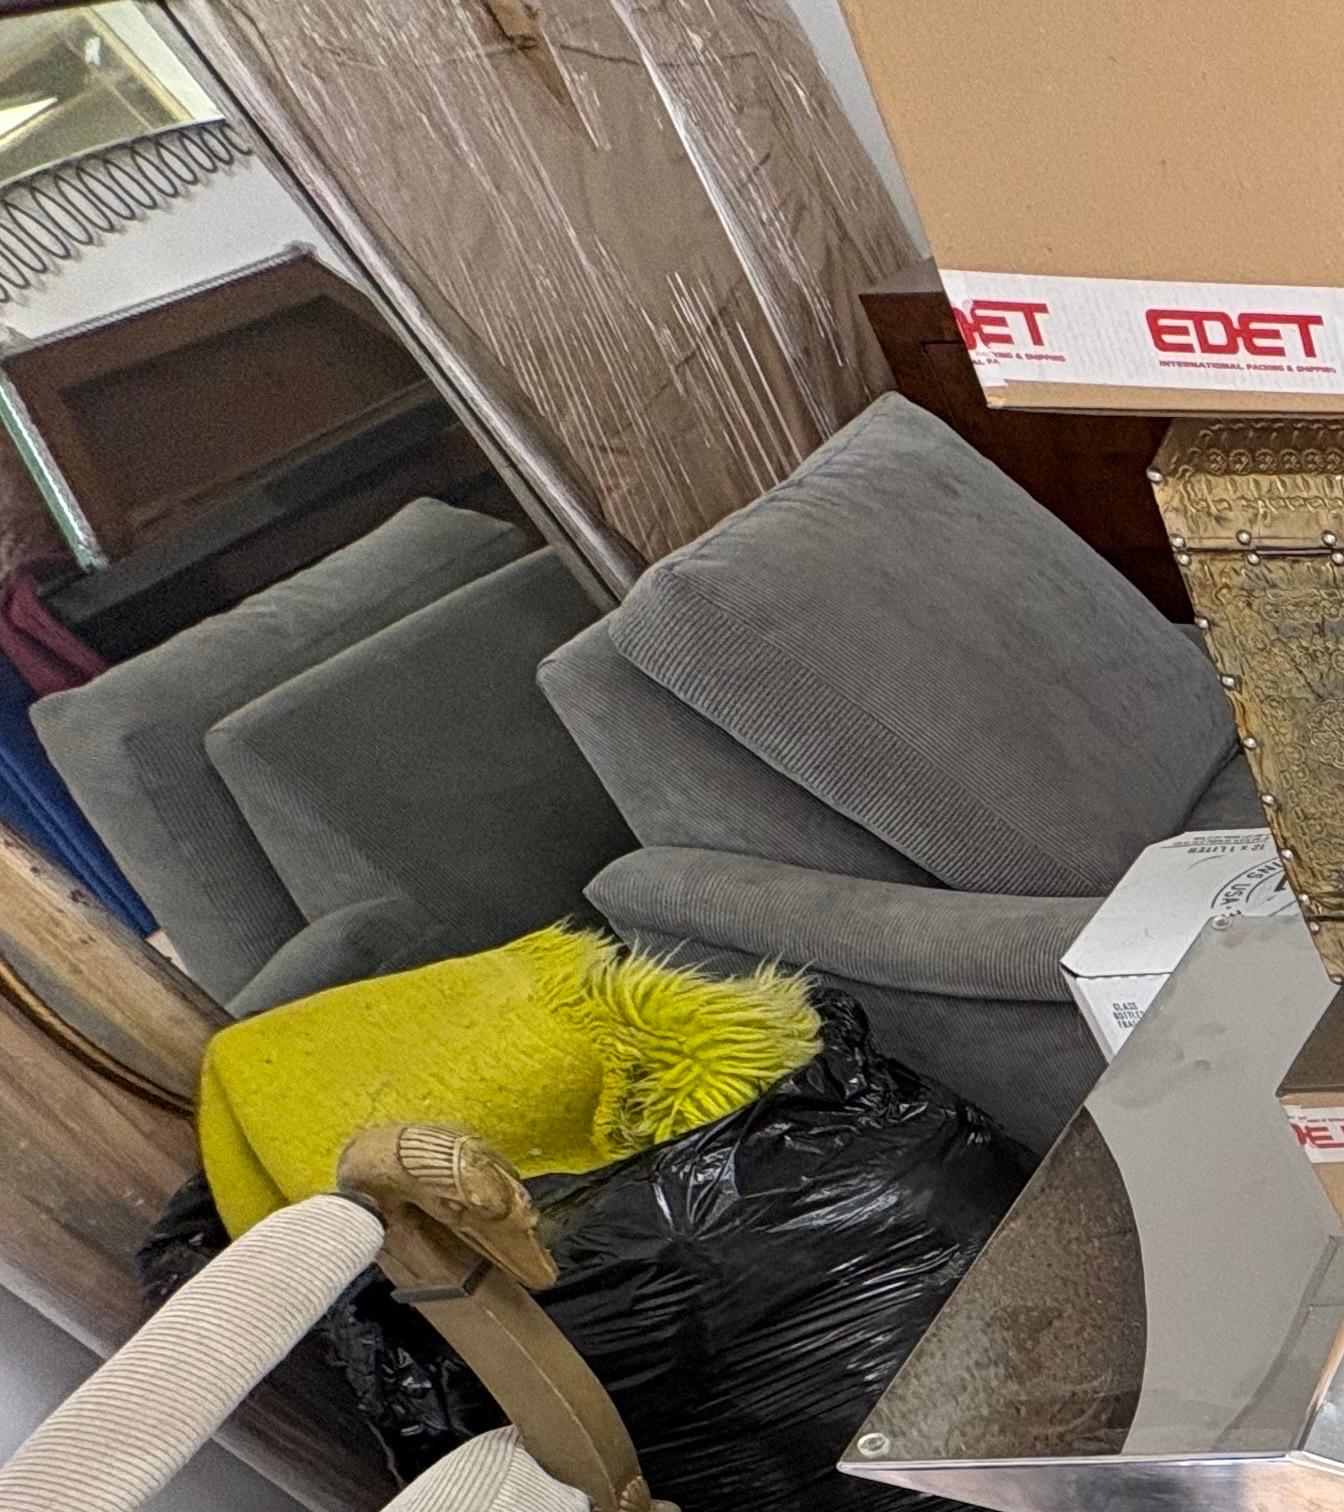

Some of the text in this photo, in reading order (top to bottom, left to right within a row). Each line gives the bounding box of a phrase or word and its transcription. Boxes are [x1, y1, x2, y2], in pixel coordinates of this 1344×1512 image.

[1145, 309, 1324, 359] EDET
[1159, 360, 1244, 370] INTERNATIONAL
[1112, 1002, 1138, 1011] GLASS
